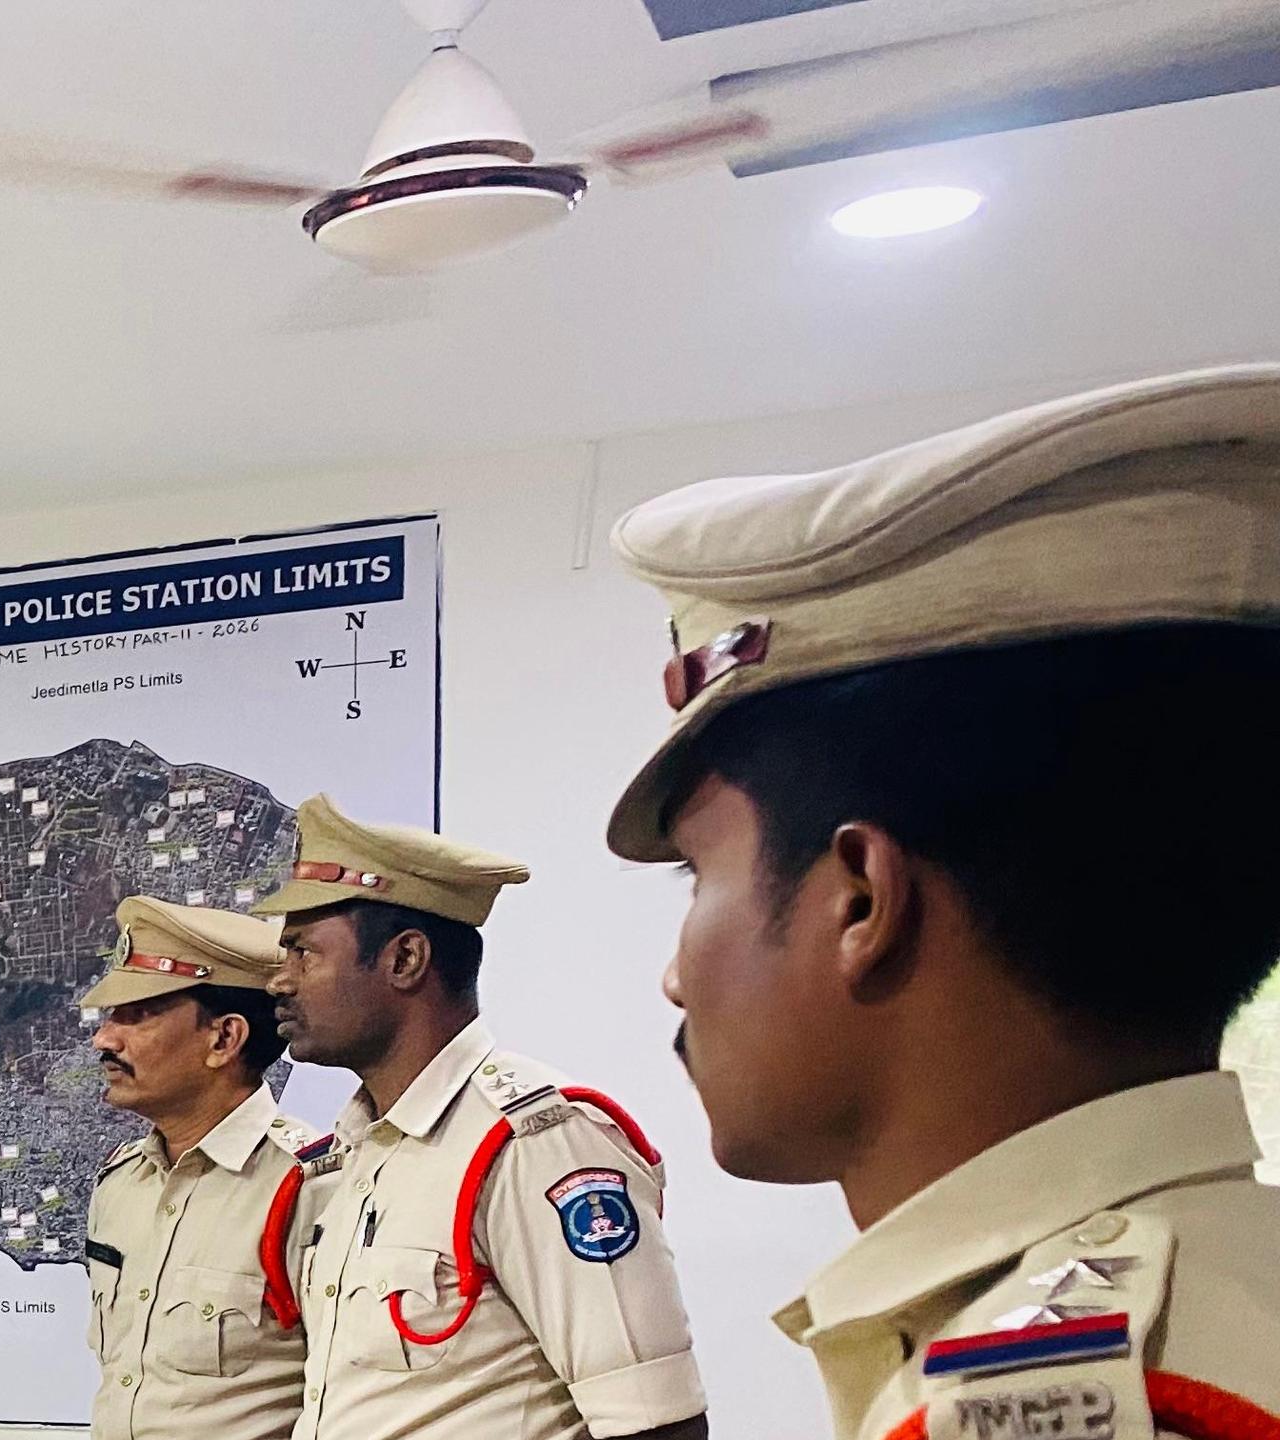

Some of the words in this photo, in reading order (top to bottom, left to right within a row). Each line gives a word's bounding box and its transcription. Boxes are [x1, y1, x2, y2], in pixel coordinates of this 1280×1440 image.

[4, 590, 112, 627] POLICE
[122, 571, 263, 612] STATION
[272, 555, 392, 592] LIMITS
[345, 611, 366, 631] N
[44, 637, 128, 660] HISTORY
[212, 618, 260, 638] 2026
[296, 659, 321, 679] W
[388, 649, 407, 669] E
[31, 680, 109, 700] Jeedimetla
[113, 676, 135, 690] PS
[139, 672, 183, 689] Limits
[346, 701, 361, 719] S
[15, 1299, 56, 1314] Limits
